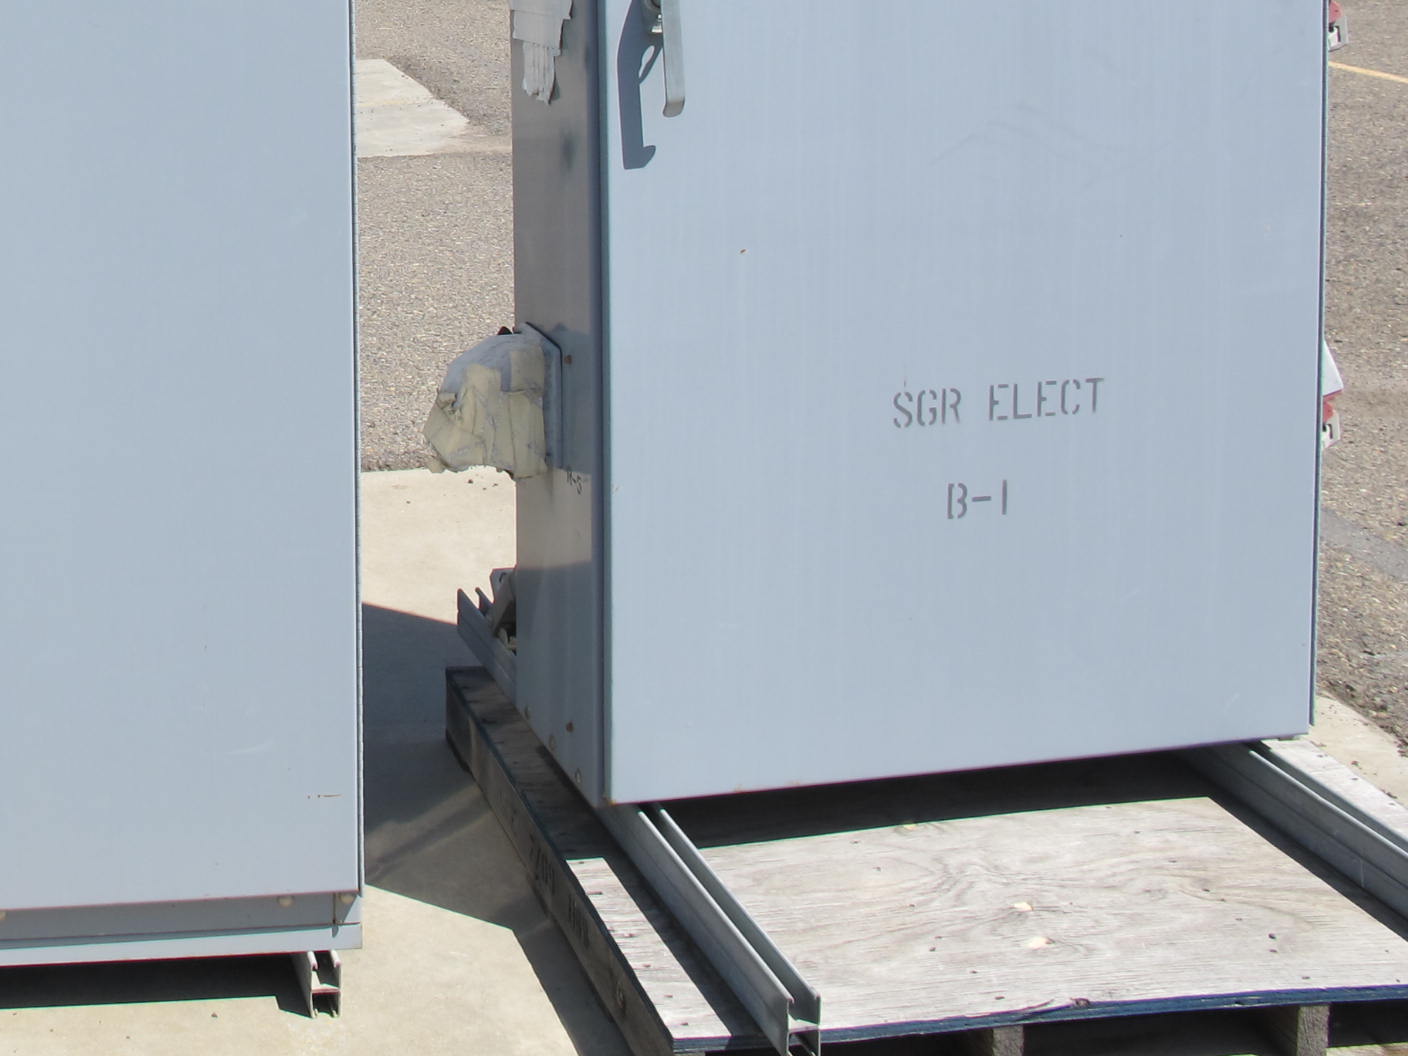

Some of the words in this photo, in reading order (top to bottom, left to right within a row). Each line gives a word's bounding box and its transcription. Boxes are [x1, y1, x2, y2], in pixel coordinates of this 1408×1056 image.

[893, 387, 962, 428] SGR
[989, 378, 1105, 421] ELECT
[947, 479, 1008, 520] B-1
